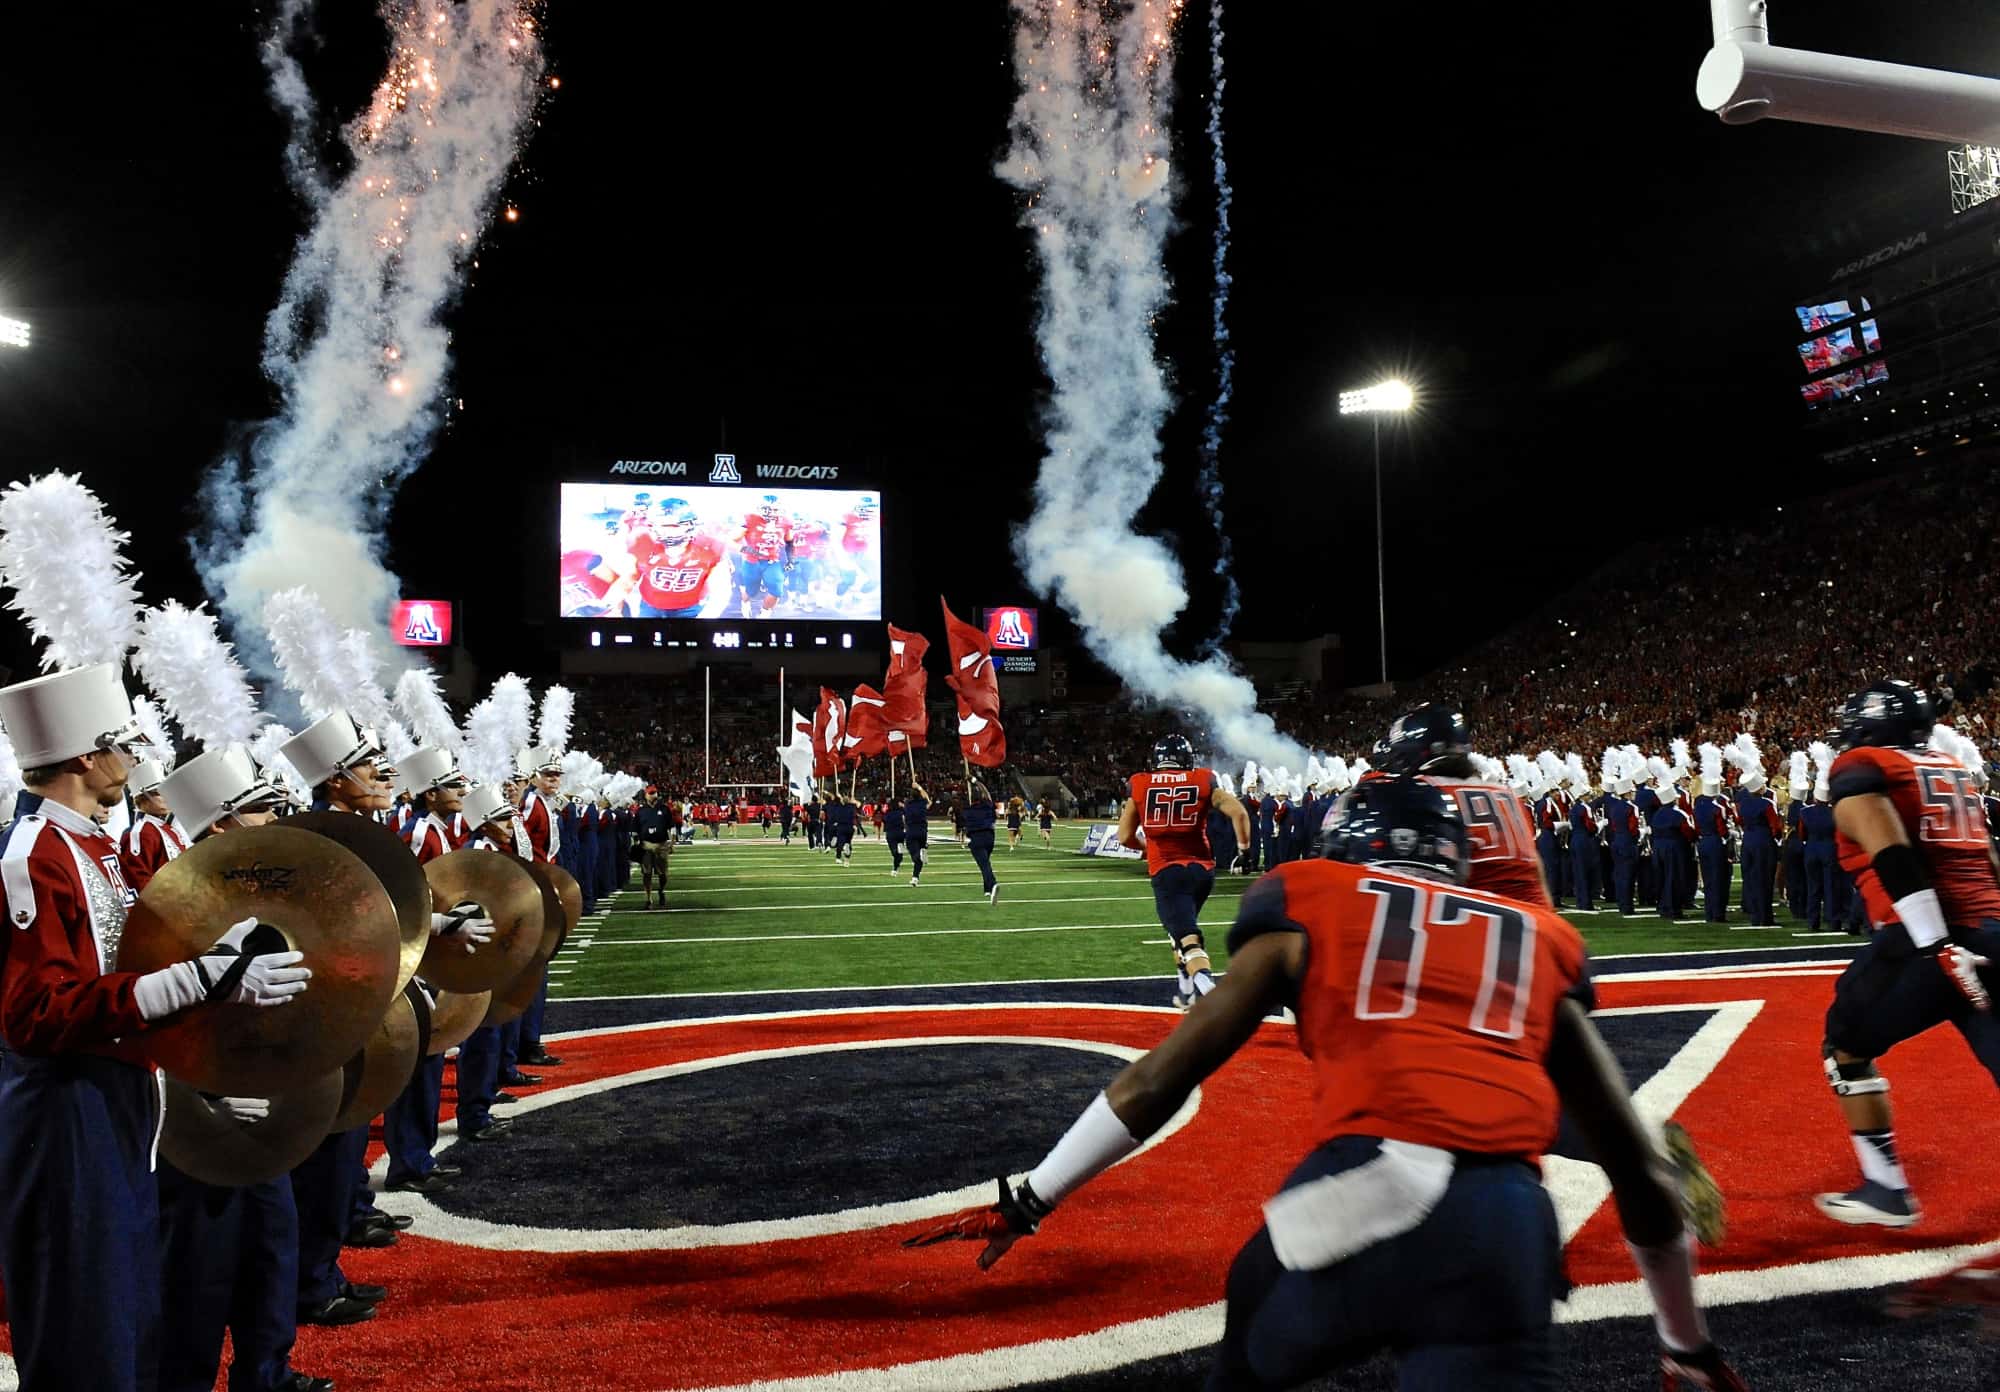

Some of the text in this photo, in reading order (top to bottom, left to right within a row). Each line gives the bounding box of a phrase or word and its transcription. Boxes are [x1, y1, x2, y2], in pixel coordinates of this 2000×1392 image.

[610, 454, 839, 483] ARIZONA A WILDCATS
[404, 604, 442, 643] A
[996, 611, 1029, 648] A
[1144, 785, 1199, 828] 62
[1355, 877, 1536, 1041] 17
